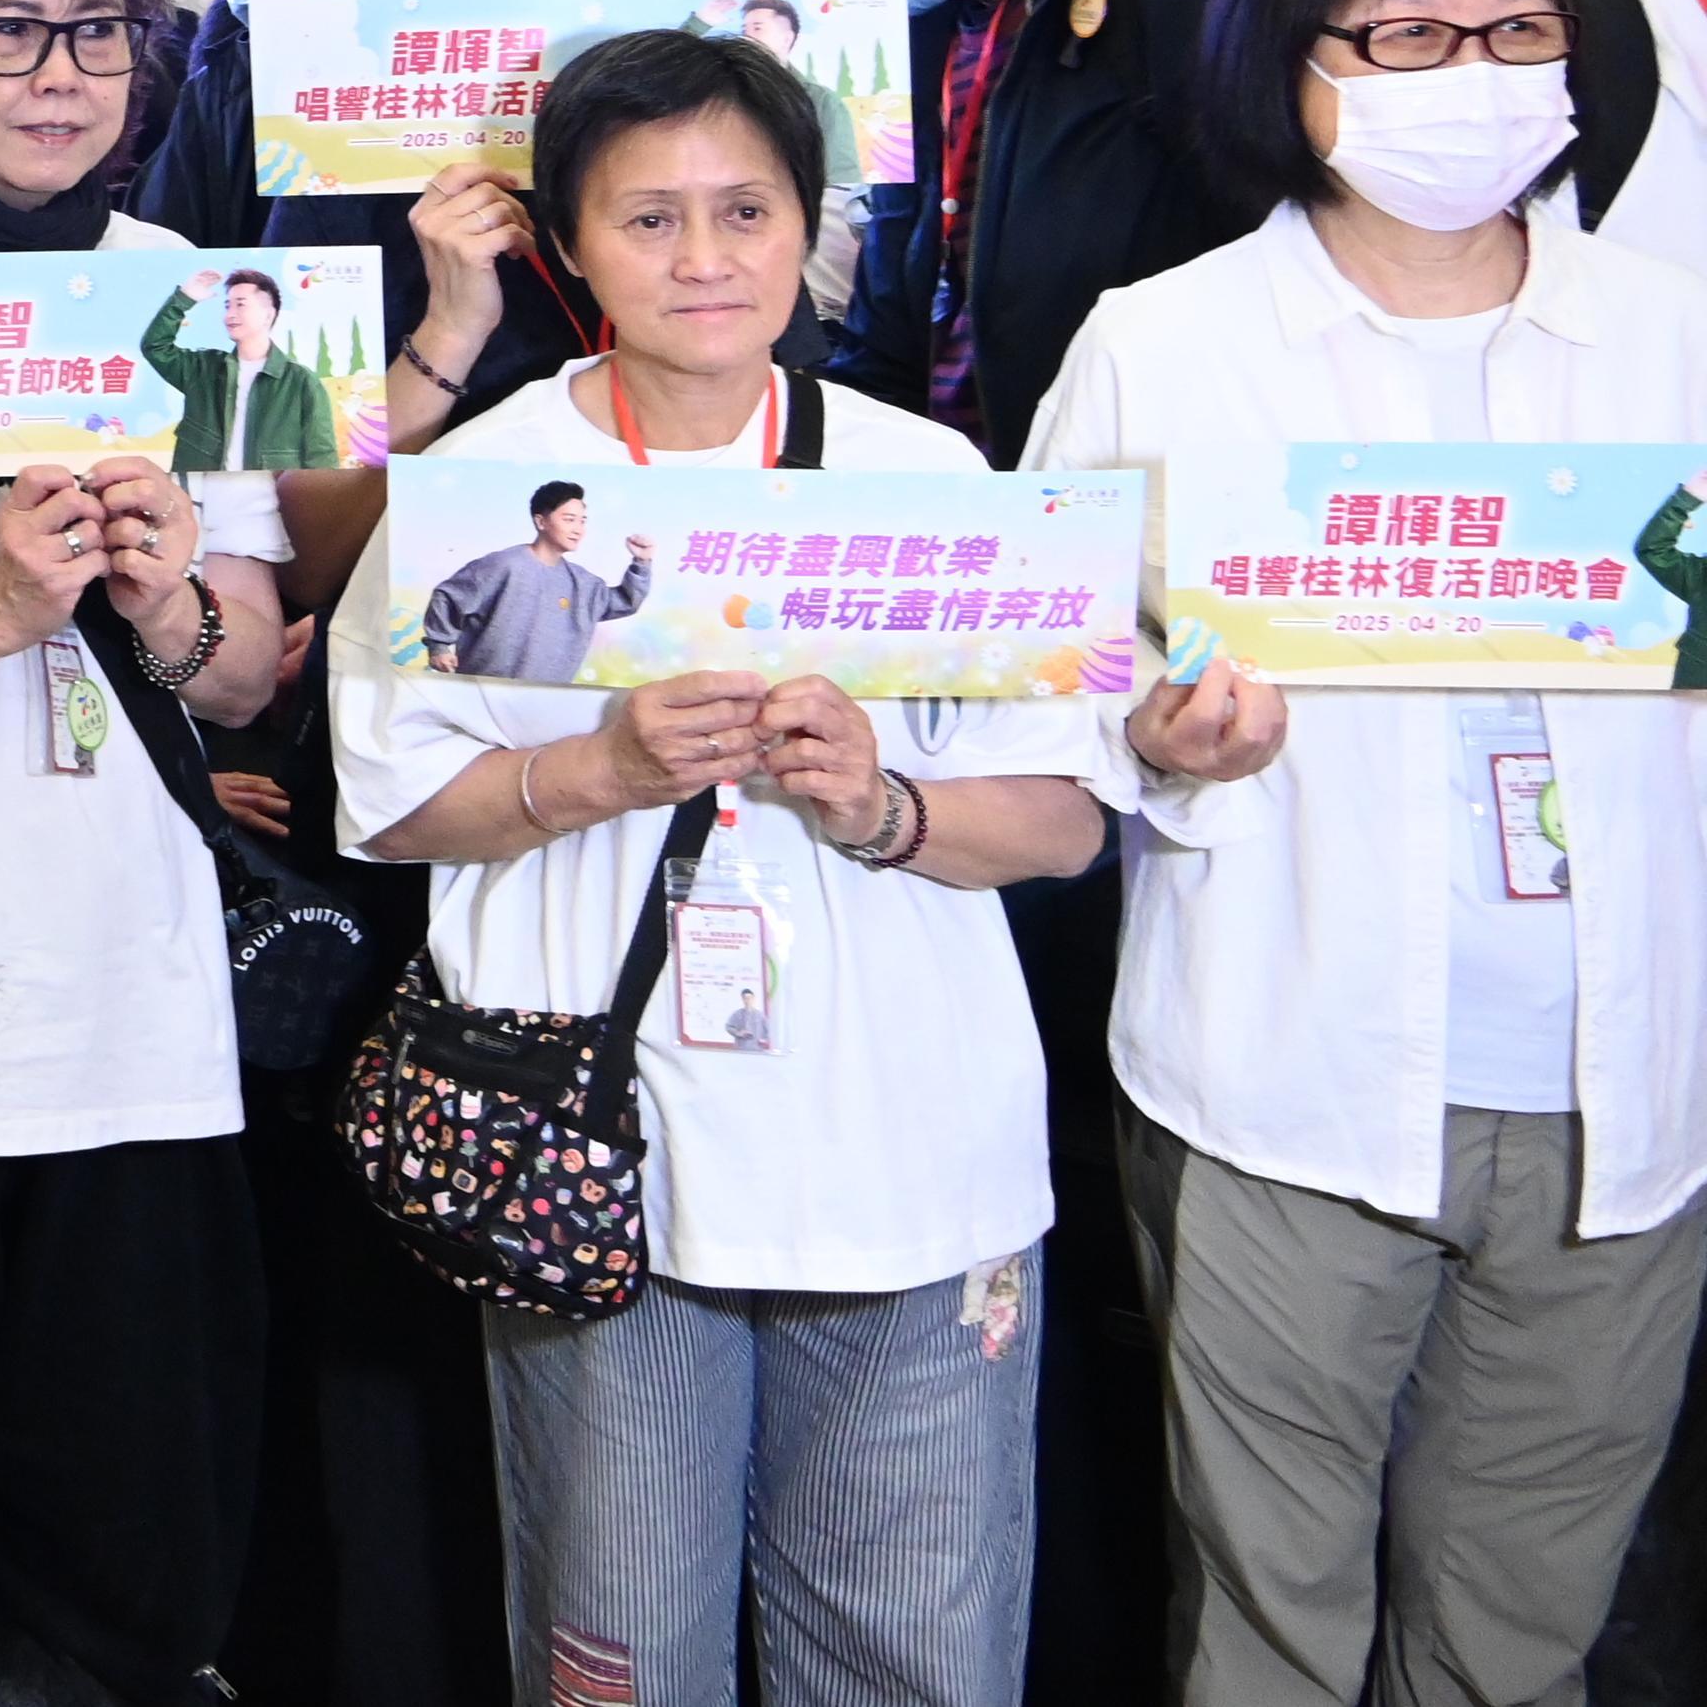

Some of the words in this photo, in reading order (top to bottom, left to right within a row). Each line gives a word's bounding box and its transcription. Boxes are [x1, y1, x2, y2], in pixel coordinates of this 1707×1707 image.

[391, 27, 547, 76] 譚輝智
[402, 132, 449, 148] 2025
[1324, 494, 1506, 548] 譚輝智
[676, 530, 1002, 579] 期待盡興歡樂
[1211, 555, 1629, 601] 唱響桂林復活節晚會
[779, 587, 1095, 632] 暢玩盡情奔放
[1335, 614, 1391, 633] 2025
[233, 919, 285, 972] LOUIS
[288, 906, 363, 945] VUITTON
